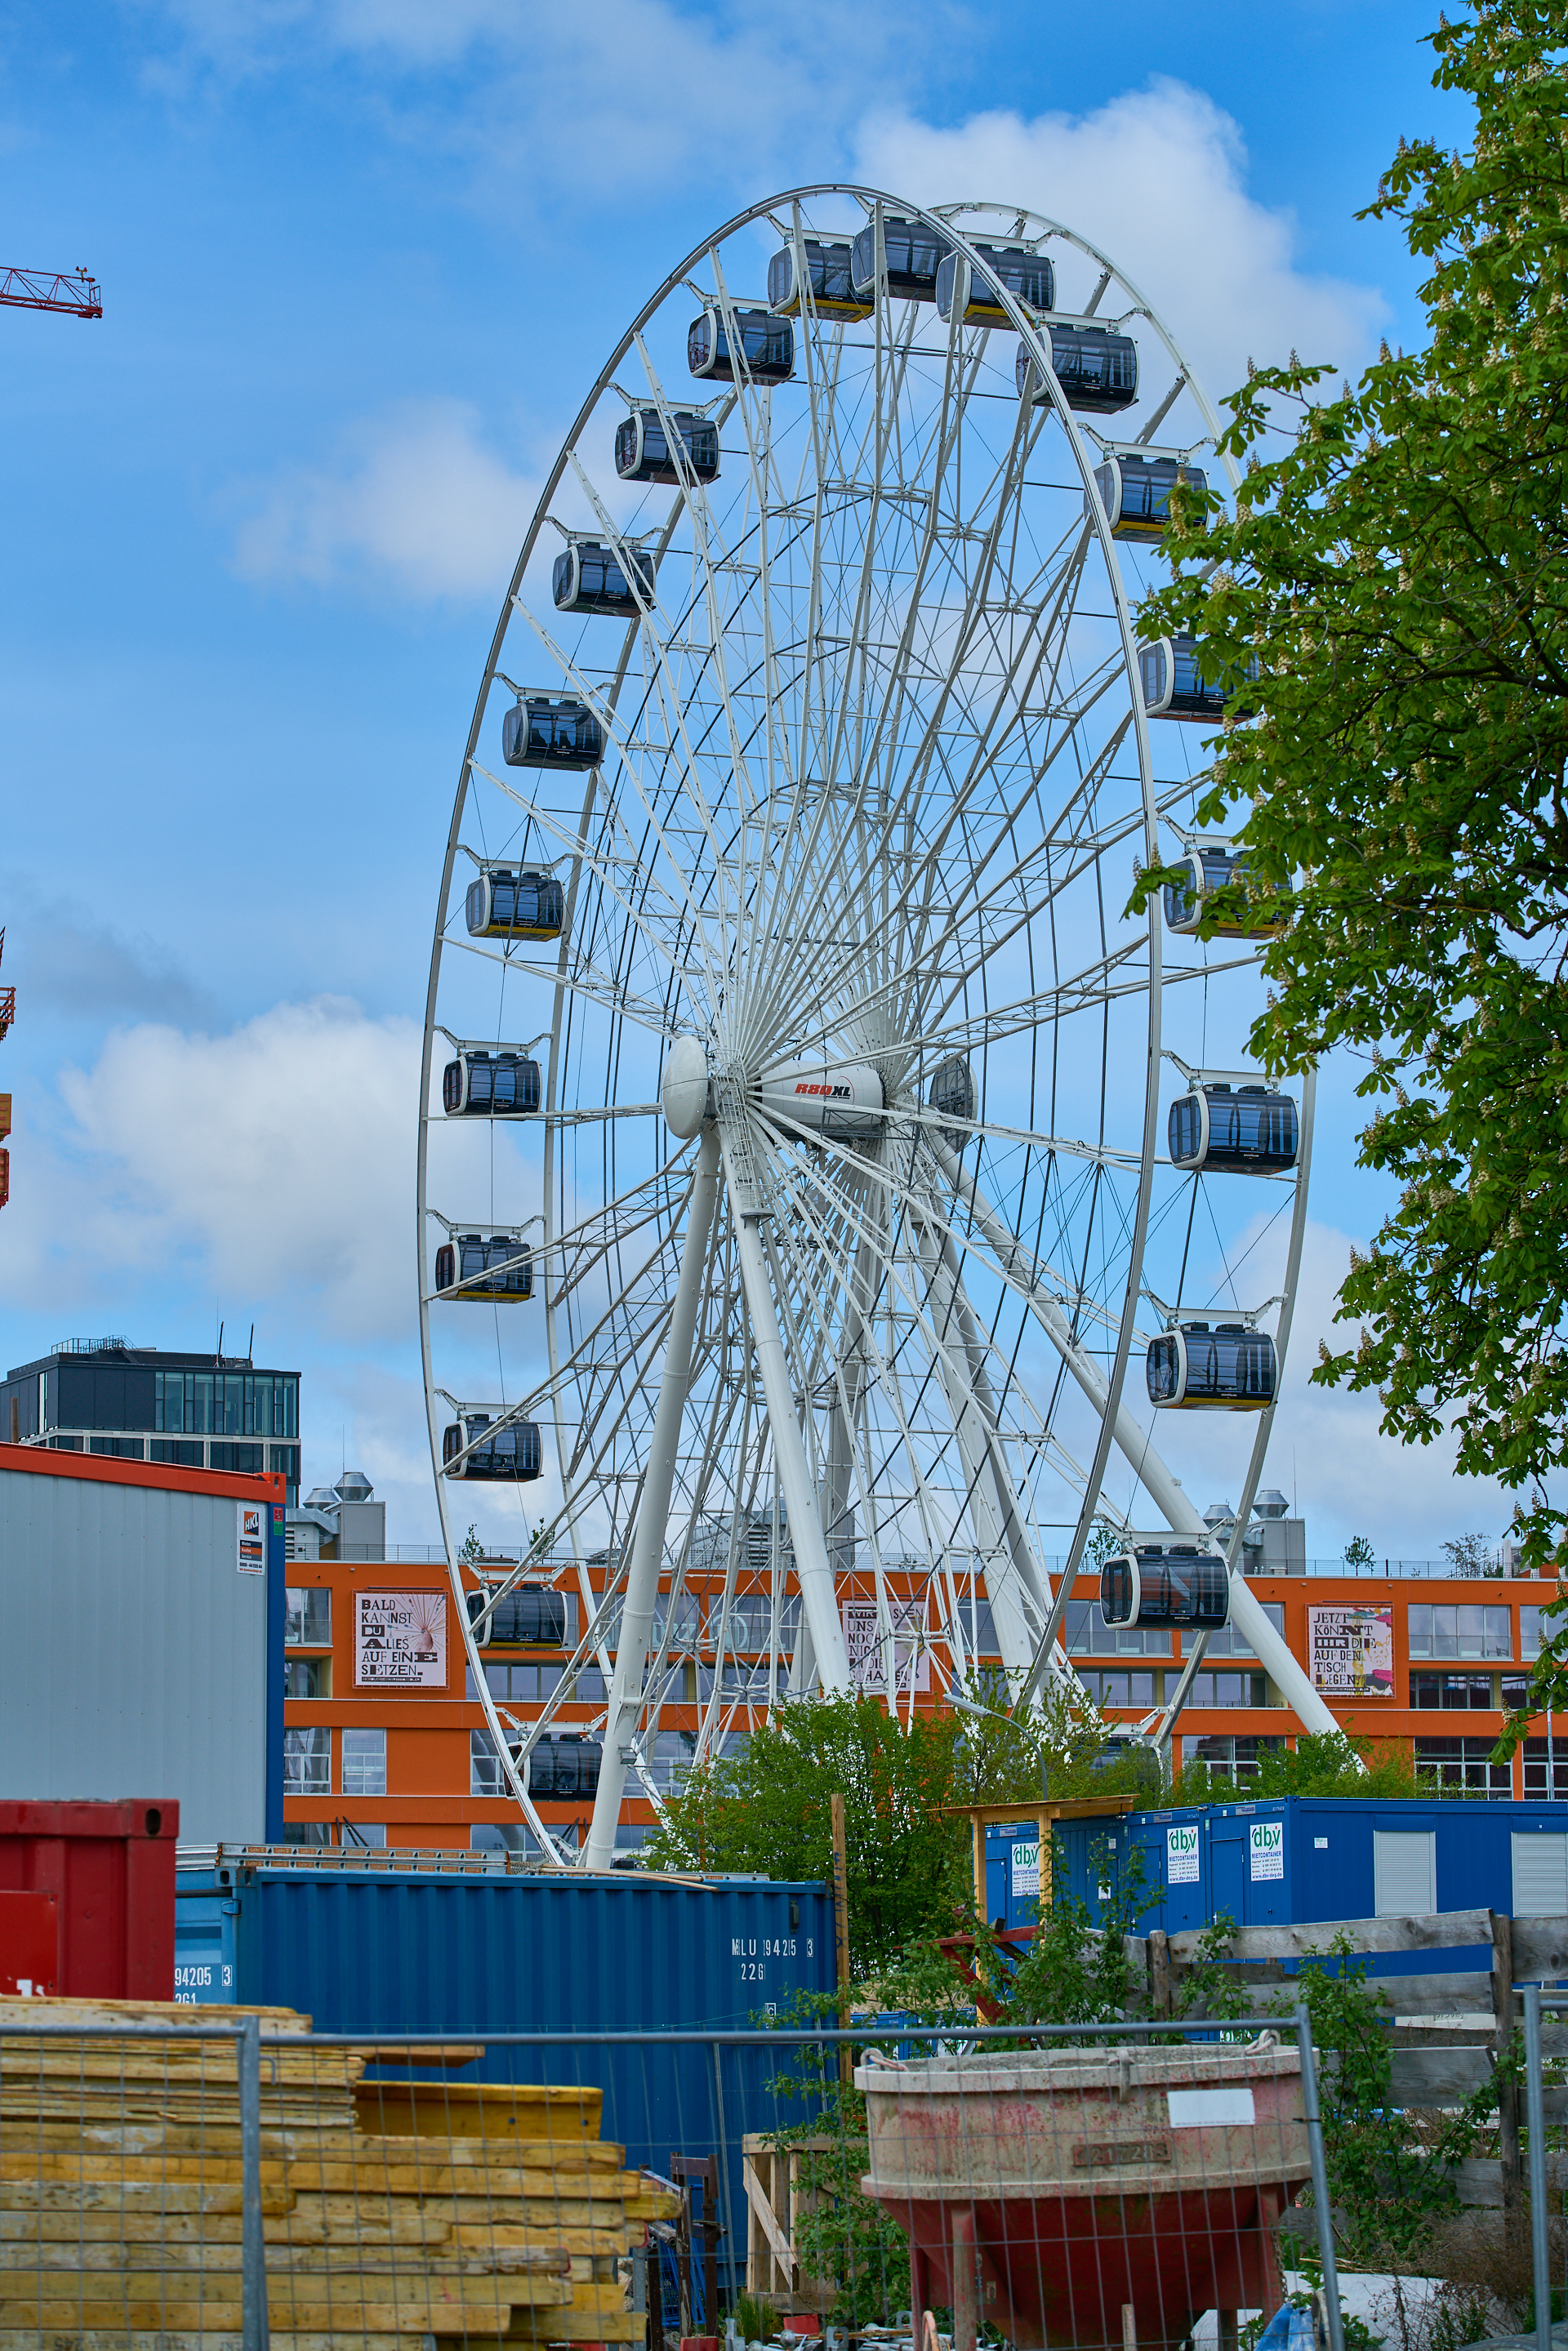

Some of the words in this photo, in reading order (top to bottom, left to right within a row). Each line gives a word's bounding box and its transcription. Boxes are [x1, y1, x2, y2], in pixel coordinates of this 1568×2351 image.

[795, 1084, 850, 1096] R80XL
[245, 1512, 259, 1531] HKL
[362, 1599, 395, 1610] BALD
[362, 1612, 412, 1623] KANNST
[851, 1608, 875, 1618] WIR
[1313, 1613, 1349, 1623] JETZT
[363, 1626, 383, 1636] DU
[848, 1621, 874, 1632] UNS
[362, 1638, 409, 1650] ALLES
[1316, 1638, 1348, 1647] IHR
[1352, 1637, 1376, 1648] DIE
[362, 1651, 387, 1662] AUF
[392, 1651, 438, 1663] EINE
[1314, 1650, 1337, 1660] AUF
[1340, 1650, 1362, 1660] DEN
[362, 1664, 423, 1676] SETZEN.
[1314, 1662, 1346, 1672] TISCH
[1170, 1829, 1197, 1854] dbv
[1254, 1826, 1281, 1851] dbv
[1015, 1845, 1040, 1868] dbv
[1169, 1854, 1198, 1862] MIETCONTAINER
[1251, 1850, 1282, 1859] MIETCONTAINER
[223, 1966, 231, 1986] 3
